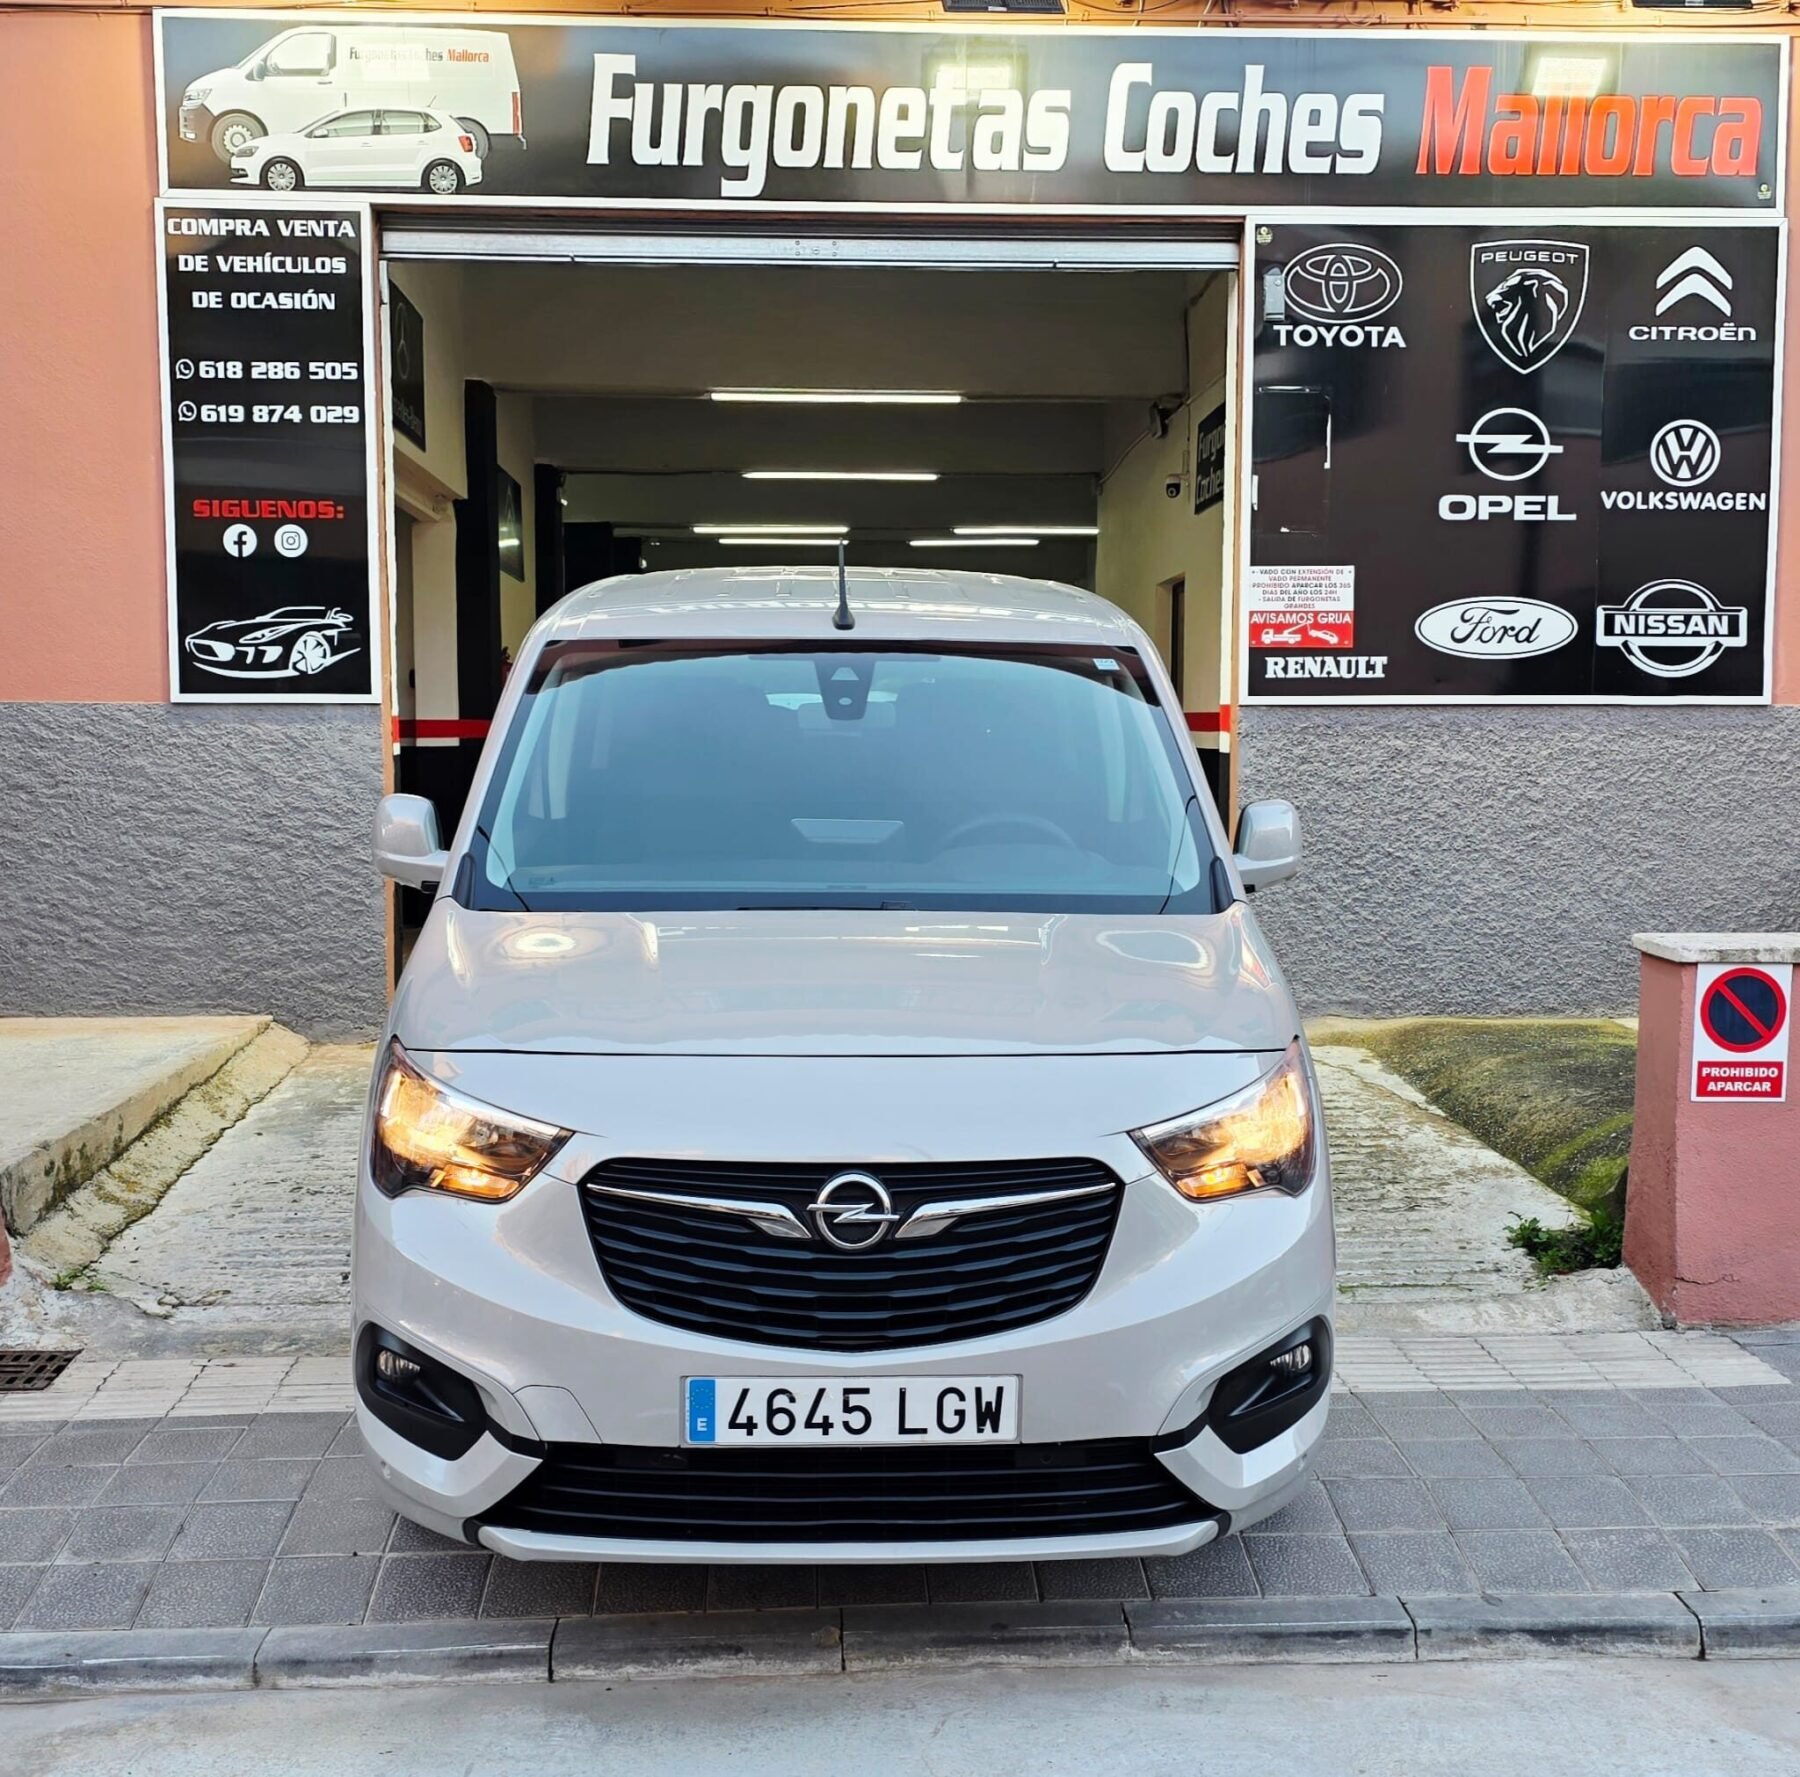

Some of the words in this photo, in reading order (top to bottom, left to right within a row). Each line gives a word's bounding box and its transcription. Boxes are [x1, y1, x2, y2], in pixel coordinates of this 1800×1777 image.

[586, 52, 1072, 198] Furgonetas
[1104, 62, 1386, 177] Coches
[1416, 64, 1762, 178] Mallorca
[167, 218, 270, 237] COMPRA
[276, 219, 356, 238] VENTA
[178, 254, 209, 272] DE
[216, 252, 347, 274] VEHÍCULOS
[1480, 250, 1580, 265] PEUGEOT
[192, 291, 223, 309] DE
[230, 289, 336, 310] OCASIÓN
[1272, 324, 1407, 349] TOYOTA
[199, 361, 243, 379] 618
[250, 361, 301, 379] 286
[308, 361, 358, 380] 505
[200, 404, 245, 423] 619
[252, 405, 303, 423] 874
[309, 405, 360, 423] 029
[192, 499, 345, 519] SIGUENOS:
[1437, 494, 1578, 521] OPEL
[1600, 490, 1767, 512] VOLKSWAGEN
[1250, 612, 1314, 624] AVISAMOS
[1317, 612, 1352, 624] GRUA
[1450, 606, 1543, 644] Ford
[1613, 613, 1730, 636] NISSAN
[1264, 656, 1388, 679] RENAULT
[1701, 1067, 1778, 1078] PROHIBIDO
[1706, 1081, 1772, 1092] APARCAR
[697, 1418, 708, 1431] E
[728, 1387, 872, 1437] 4645
[898, 1386, 1005, 1435] LGW
